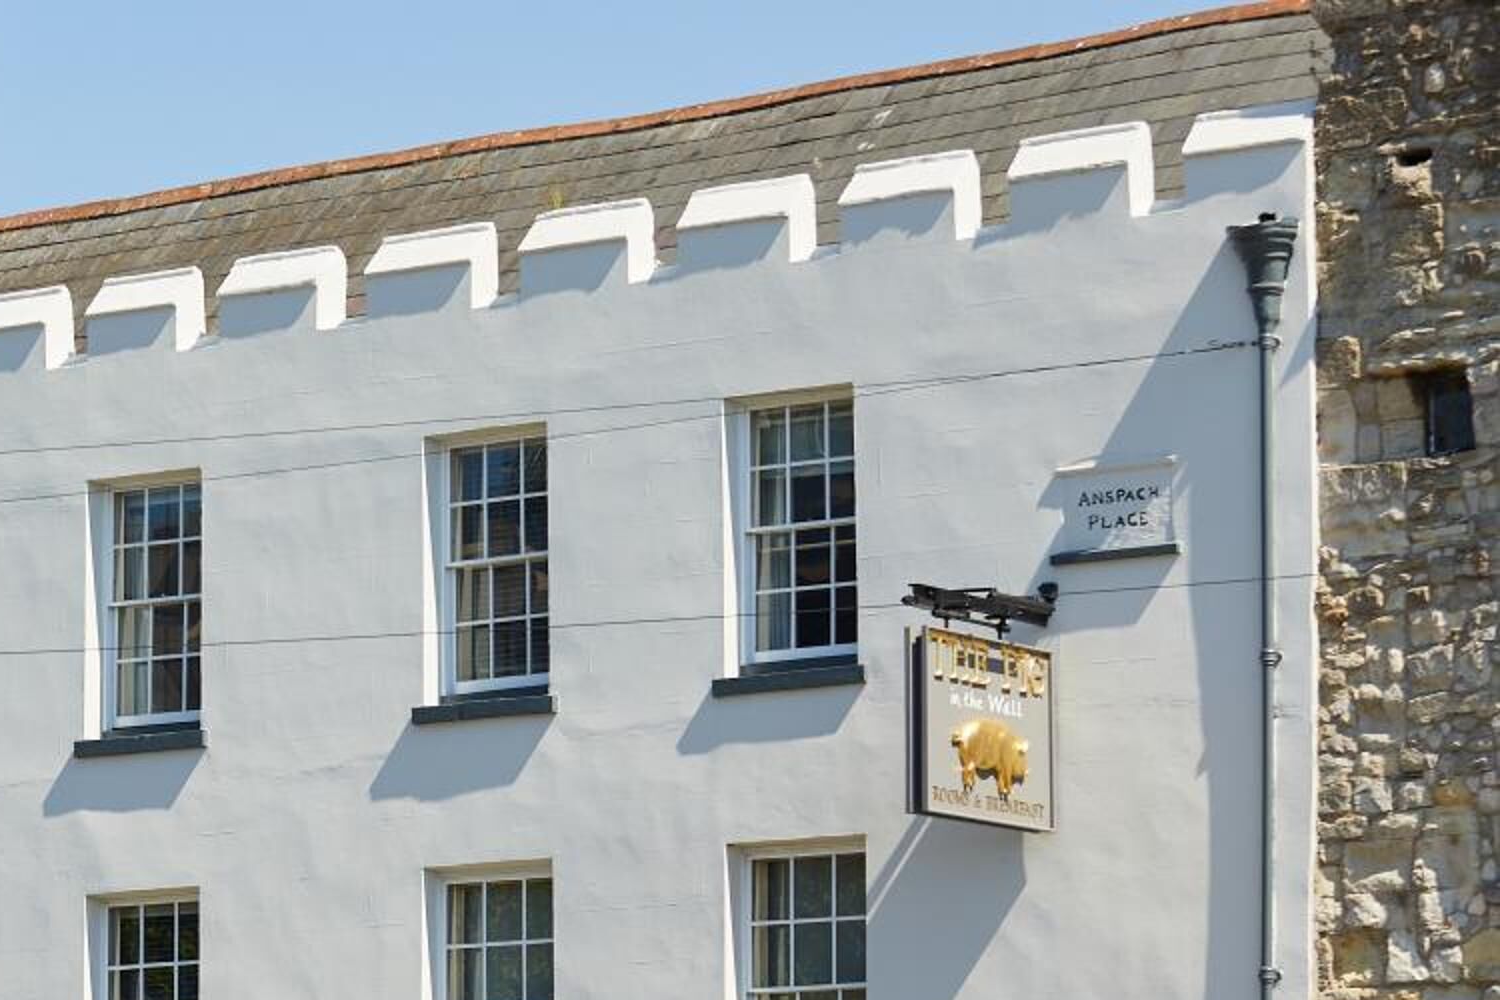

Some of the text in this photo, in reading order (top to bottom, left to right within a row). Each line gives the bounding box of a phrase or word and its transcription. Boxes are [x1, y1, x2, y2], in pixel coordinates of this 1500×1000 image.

[1078, 485, 1159, 507] ANSPACH
[1088, 512, 1149, 531] PLACE
[930, 633, 1047, 699] THE PIG
[989, 693, 1023, 717] Wall
[932, 785, 968, 806] ROOMS
[985, 796, 1044, 818] BREAKFAST
